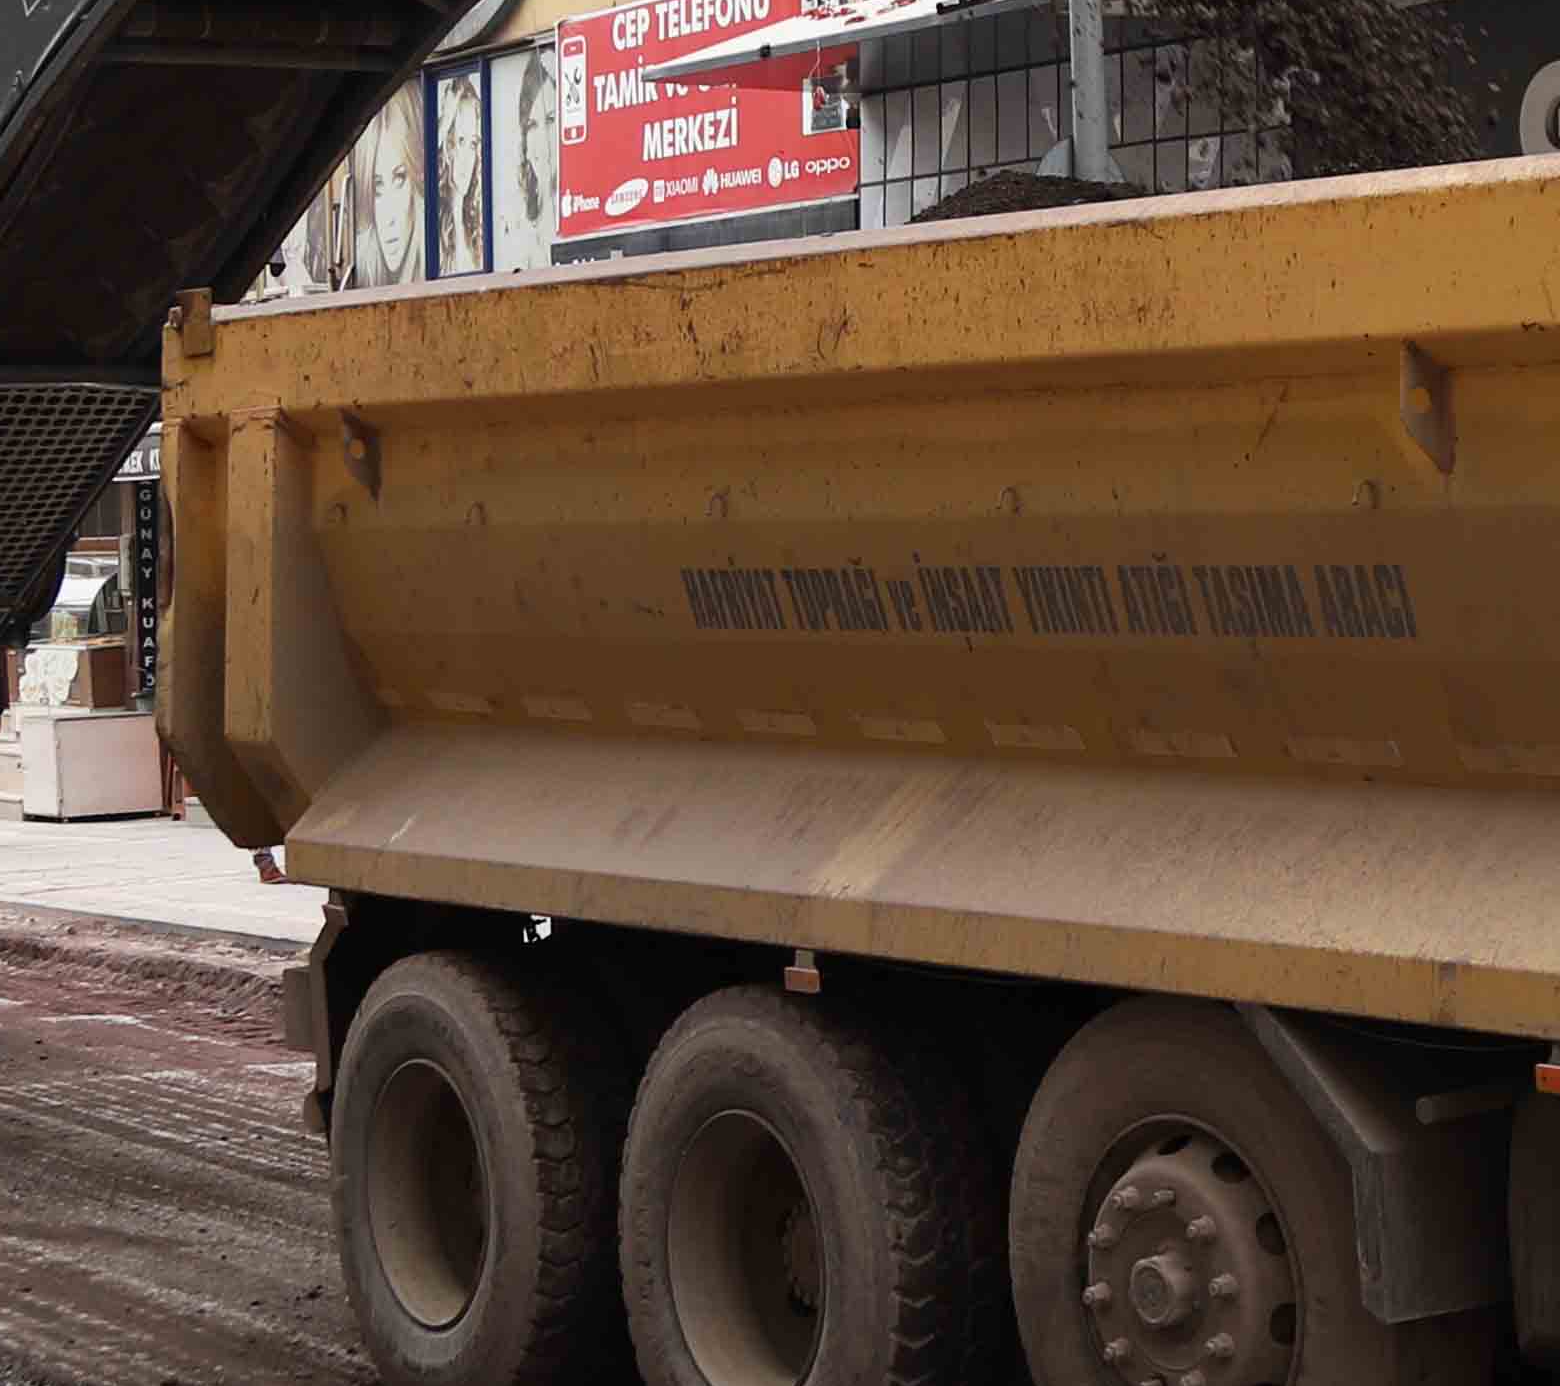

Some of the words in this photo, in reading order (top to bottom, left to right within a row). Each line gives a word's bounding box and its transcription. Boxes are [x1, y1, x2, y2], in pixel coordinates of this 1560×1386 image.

[612, 7, 650, 51] CEP
[643, 96, 737, 162] MERKEZİ
[664, 179, 699, 197] XIAOMI
[720, 167, 762, 190] HUAWEI
[784, 161, 800, 179] LG
[804, 156, 850, 176] oppo
[1313, 564, 1418, 639] ARACI
